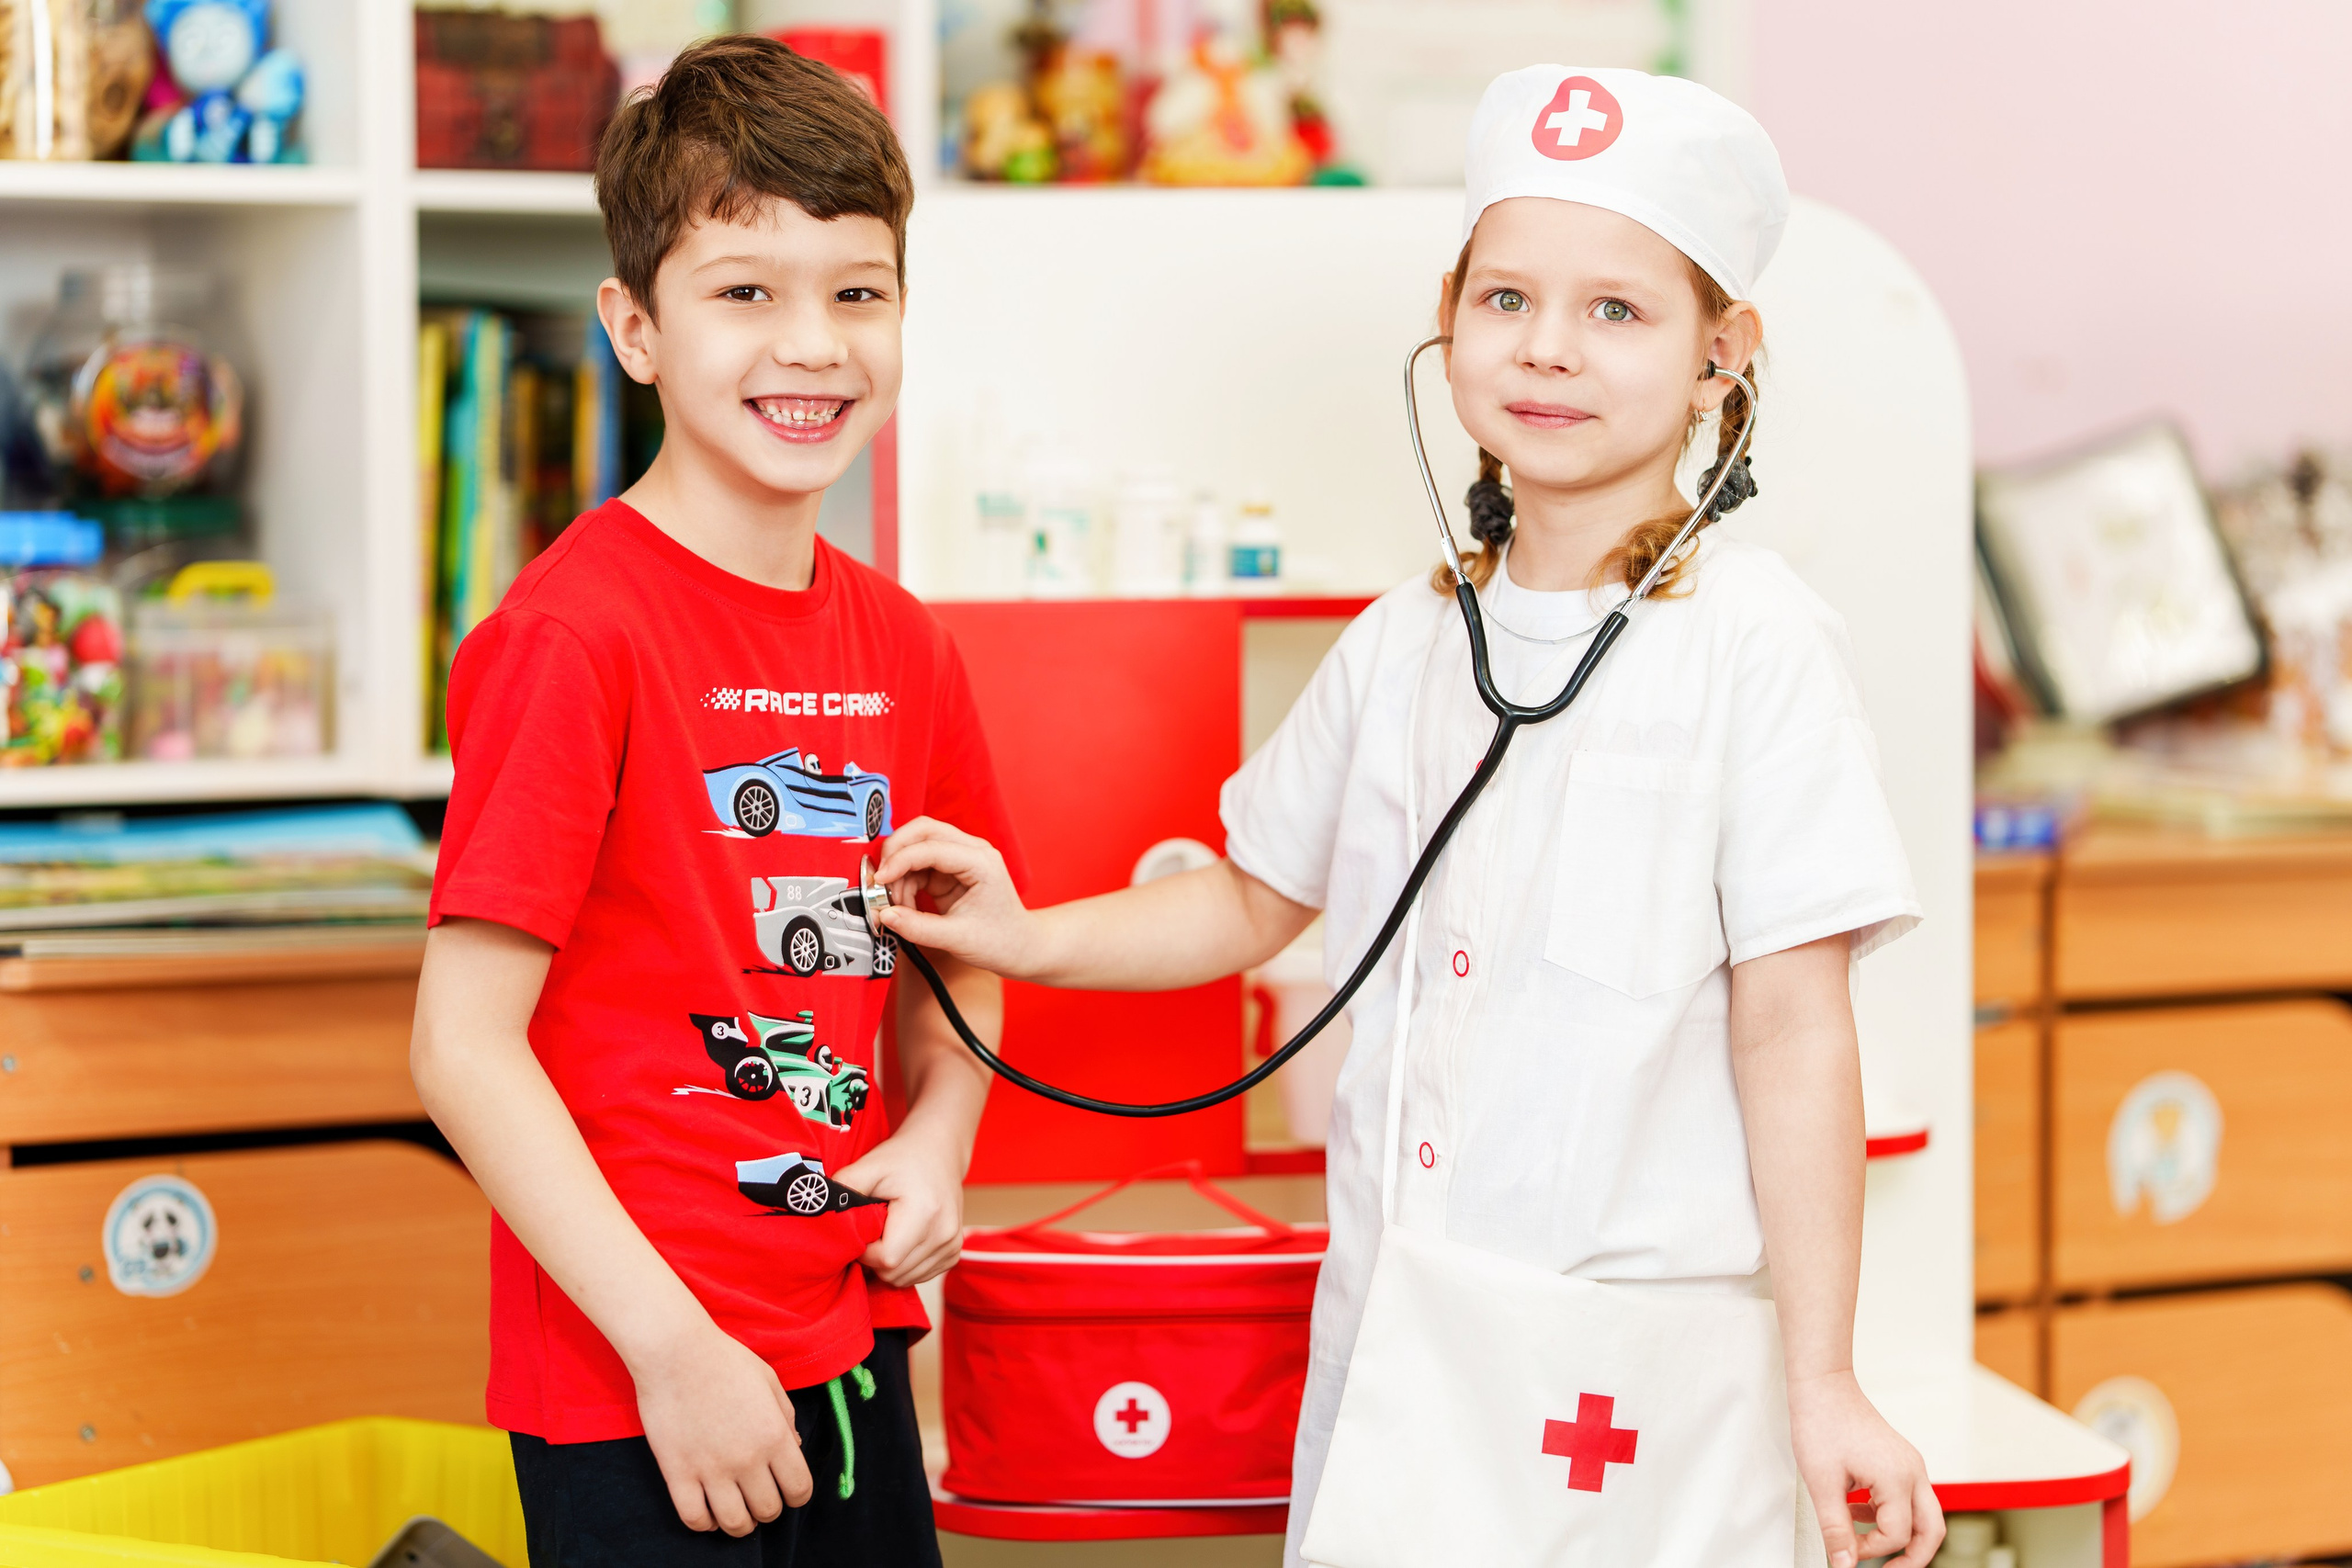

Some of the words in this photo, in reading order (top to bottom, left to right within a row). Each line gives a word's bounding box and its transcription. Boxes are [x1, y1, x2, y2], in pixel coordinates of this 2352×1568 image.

[744, 688, 818, 716] RACE
[786, 885, 802, 901] 88
[717, 1025, 725, 1036] 3
[799, 1086, 811, 1107] 3
